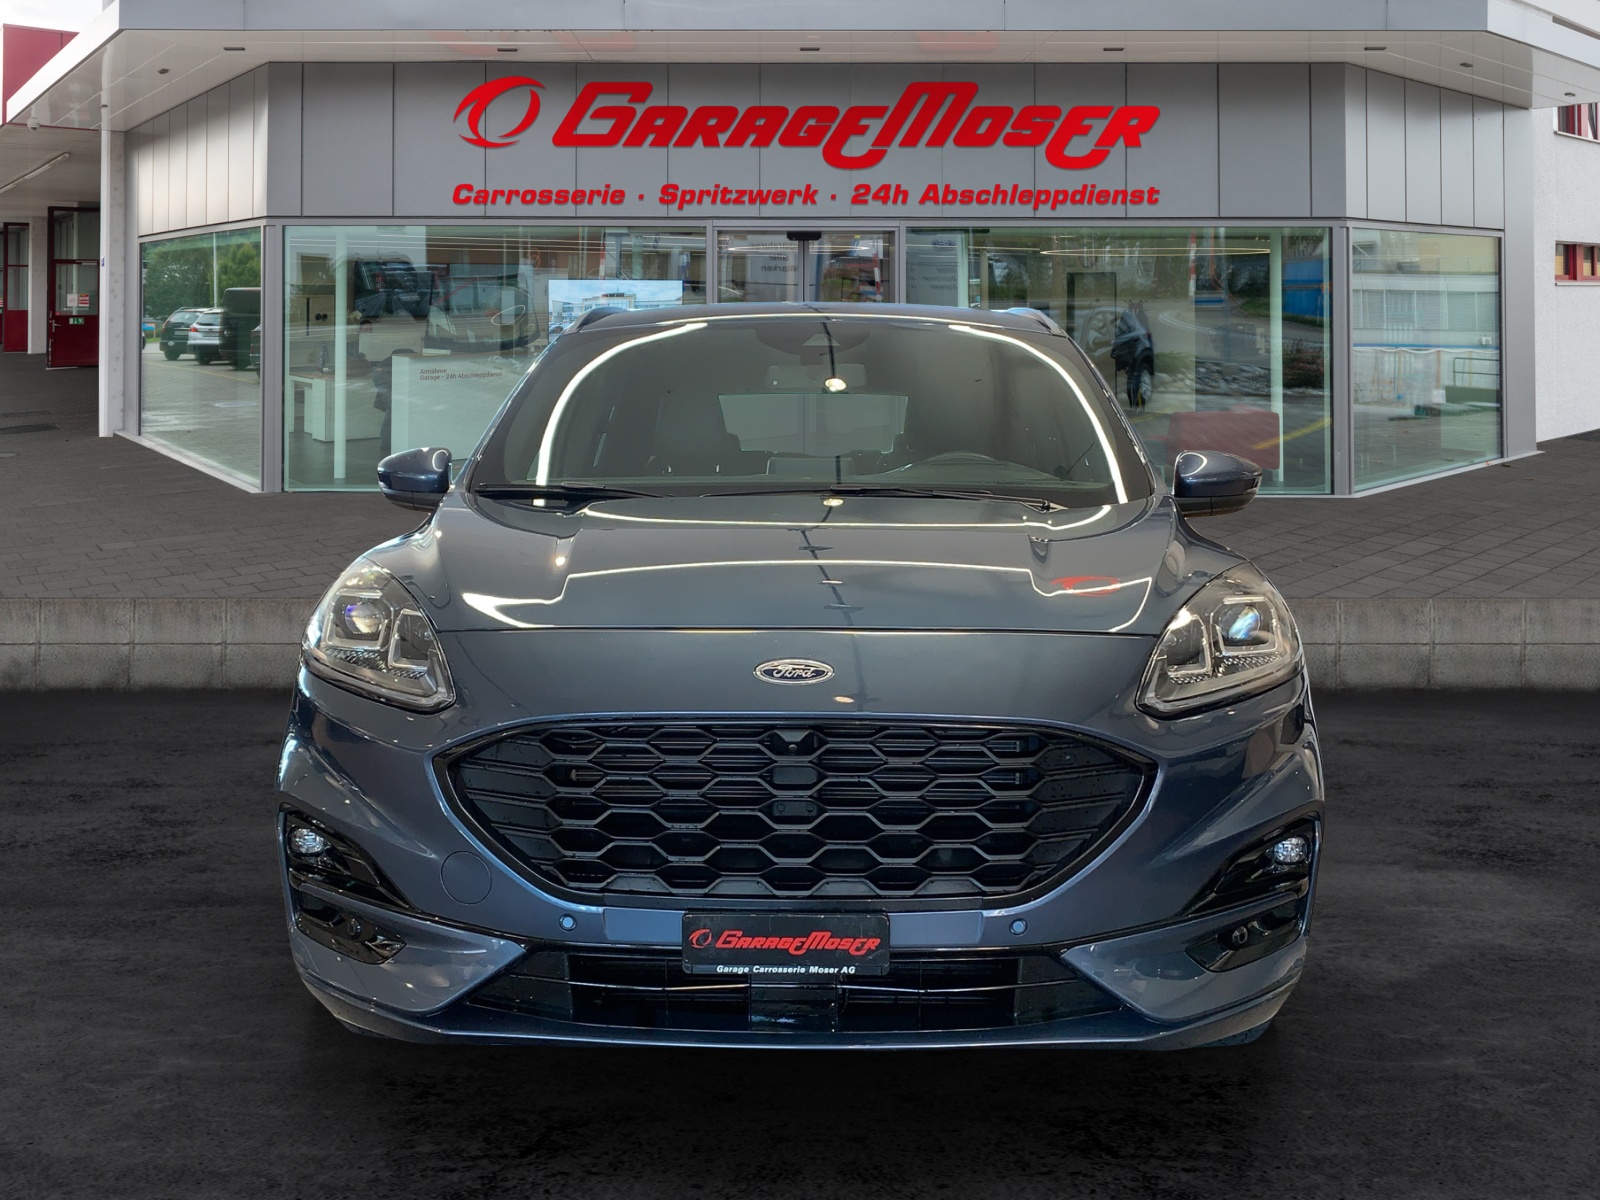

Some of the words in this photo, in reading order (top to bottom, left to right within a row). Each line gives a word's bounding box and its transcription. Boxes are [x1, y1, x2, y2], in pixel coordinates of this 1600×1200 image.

[452, 183, 626, 205] Carrosserie
[658, 183, 819, 211] Spritzwerk
[851, 183, 909, 205] 24h
[918, 183, 1161, 211] Abschleppdienst
[420, 367, 447, 375] Annahme
[458, 371, 503, 380] Abschleppdienst
[772, 664, 817, 678] Ford
[716, 965, 750, 974] Garage
[752, 965, 806, 974] Carrosserie
[808, 965, 839, 974] Moser
[841, 965, 856, 974] AG
